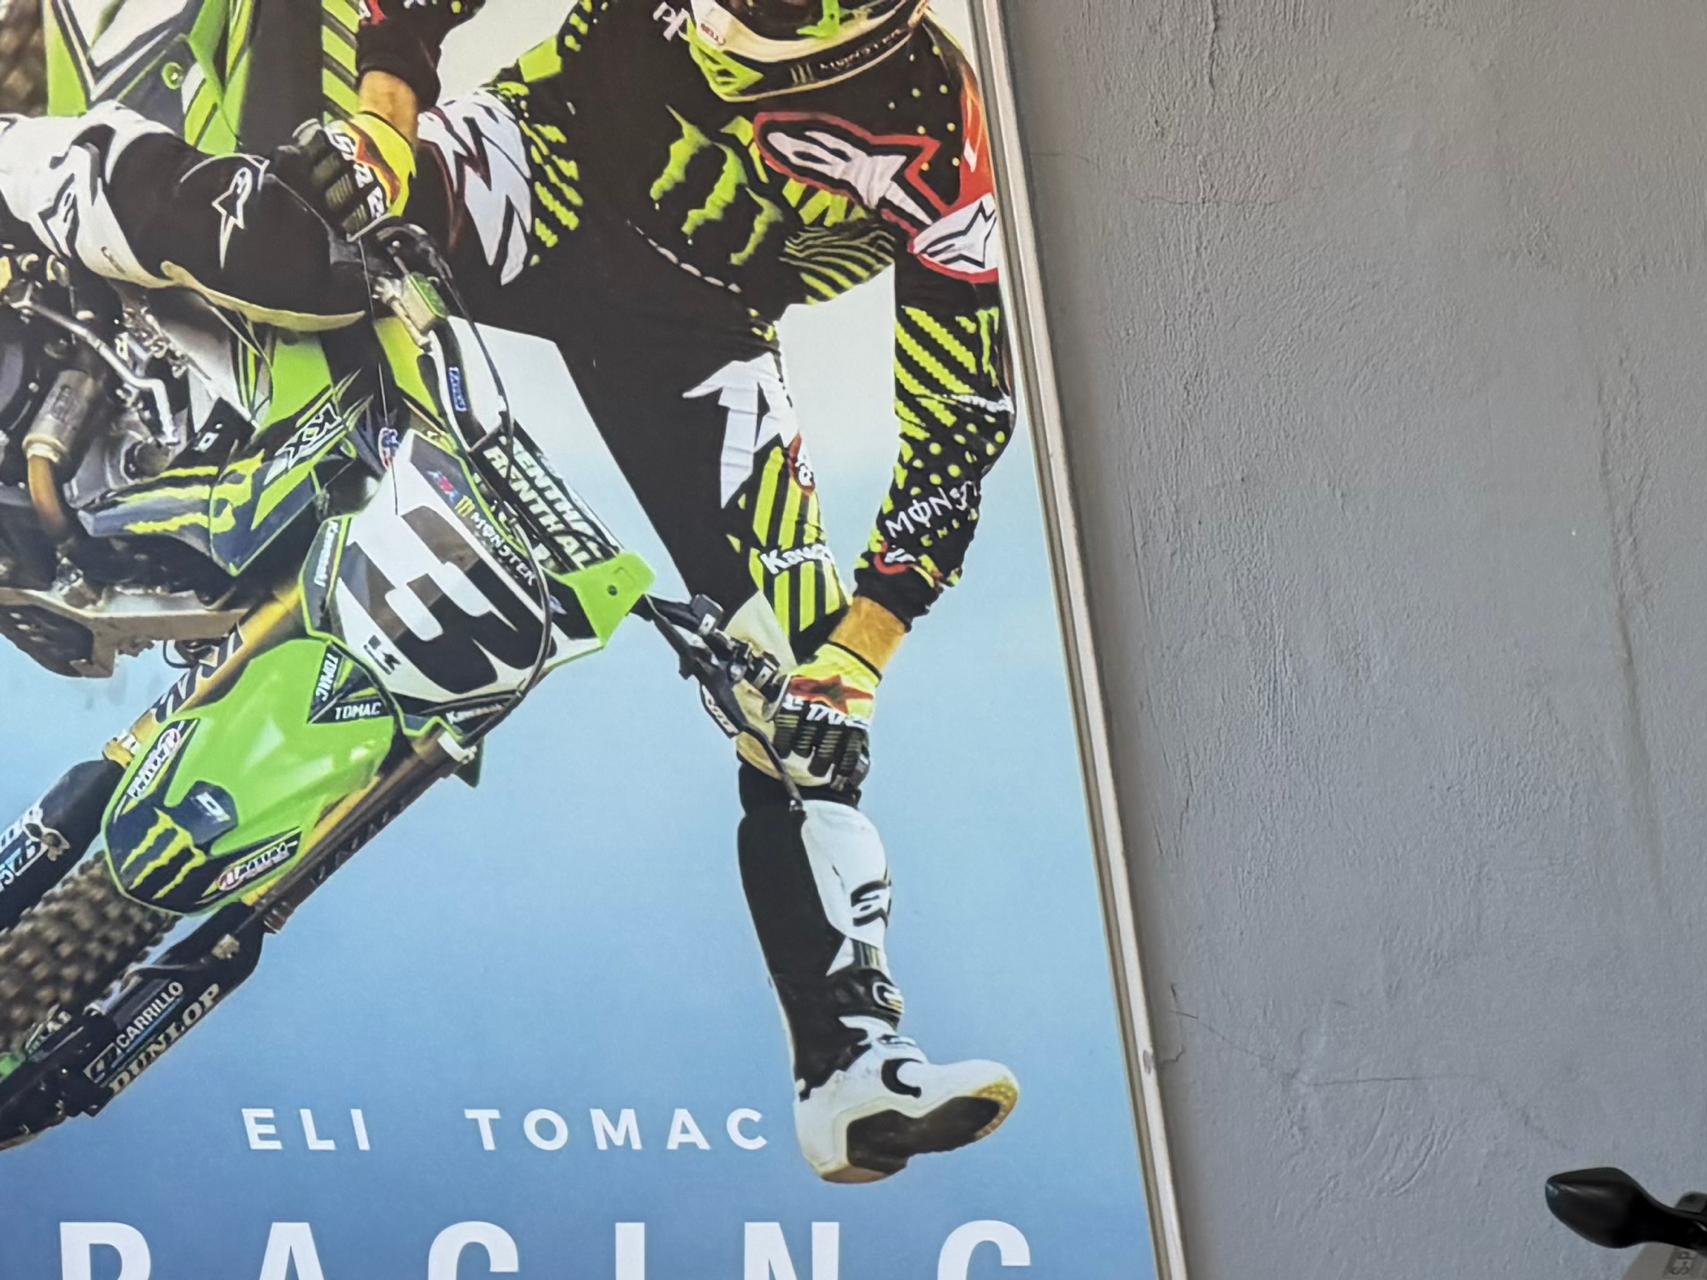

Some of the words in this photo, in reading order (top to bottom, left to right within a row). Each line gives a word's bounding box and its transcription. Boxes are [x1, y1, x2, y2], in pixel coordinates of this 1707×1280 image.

[334, 701, 384, 721] TOMAC
[108, 983, 220, 1094] DUNLOP
[116, 981, 184, 1049] CARRILLO
[241, 1109, 371, 1151] ELI
[465, 1107, 768, 1152] TOMAC
